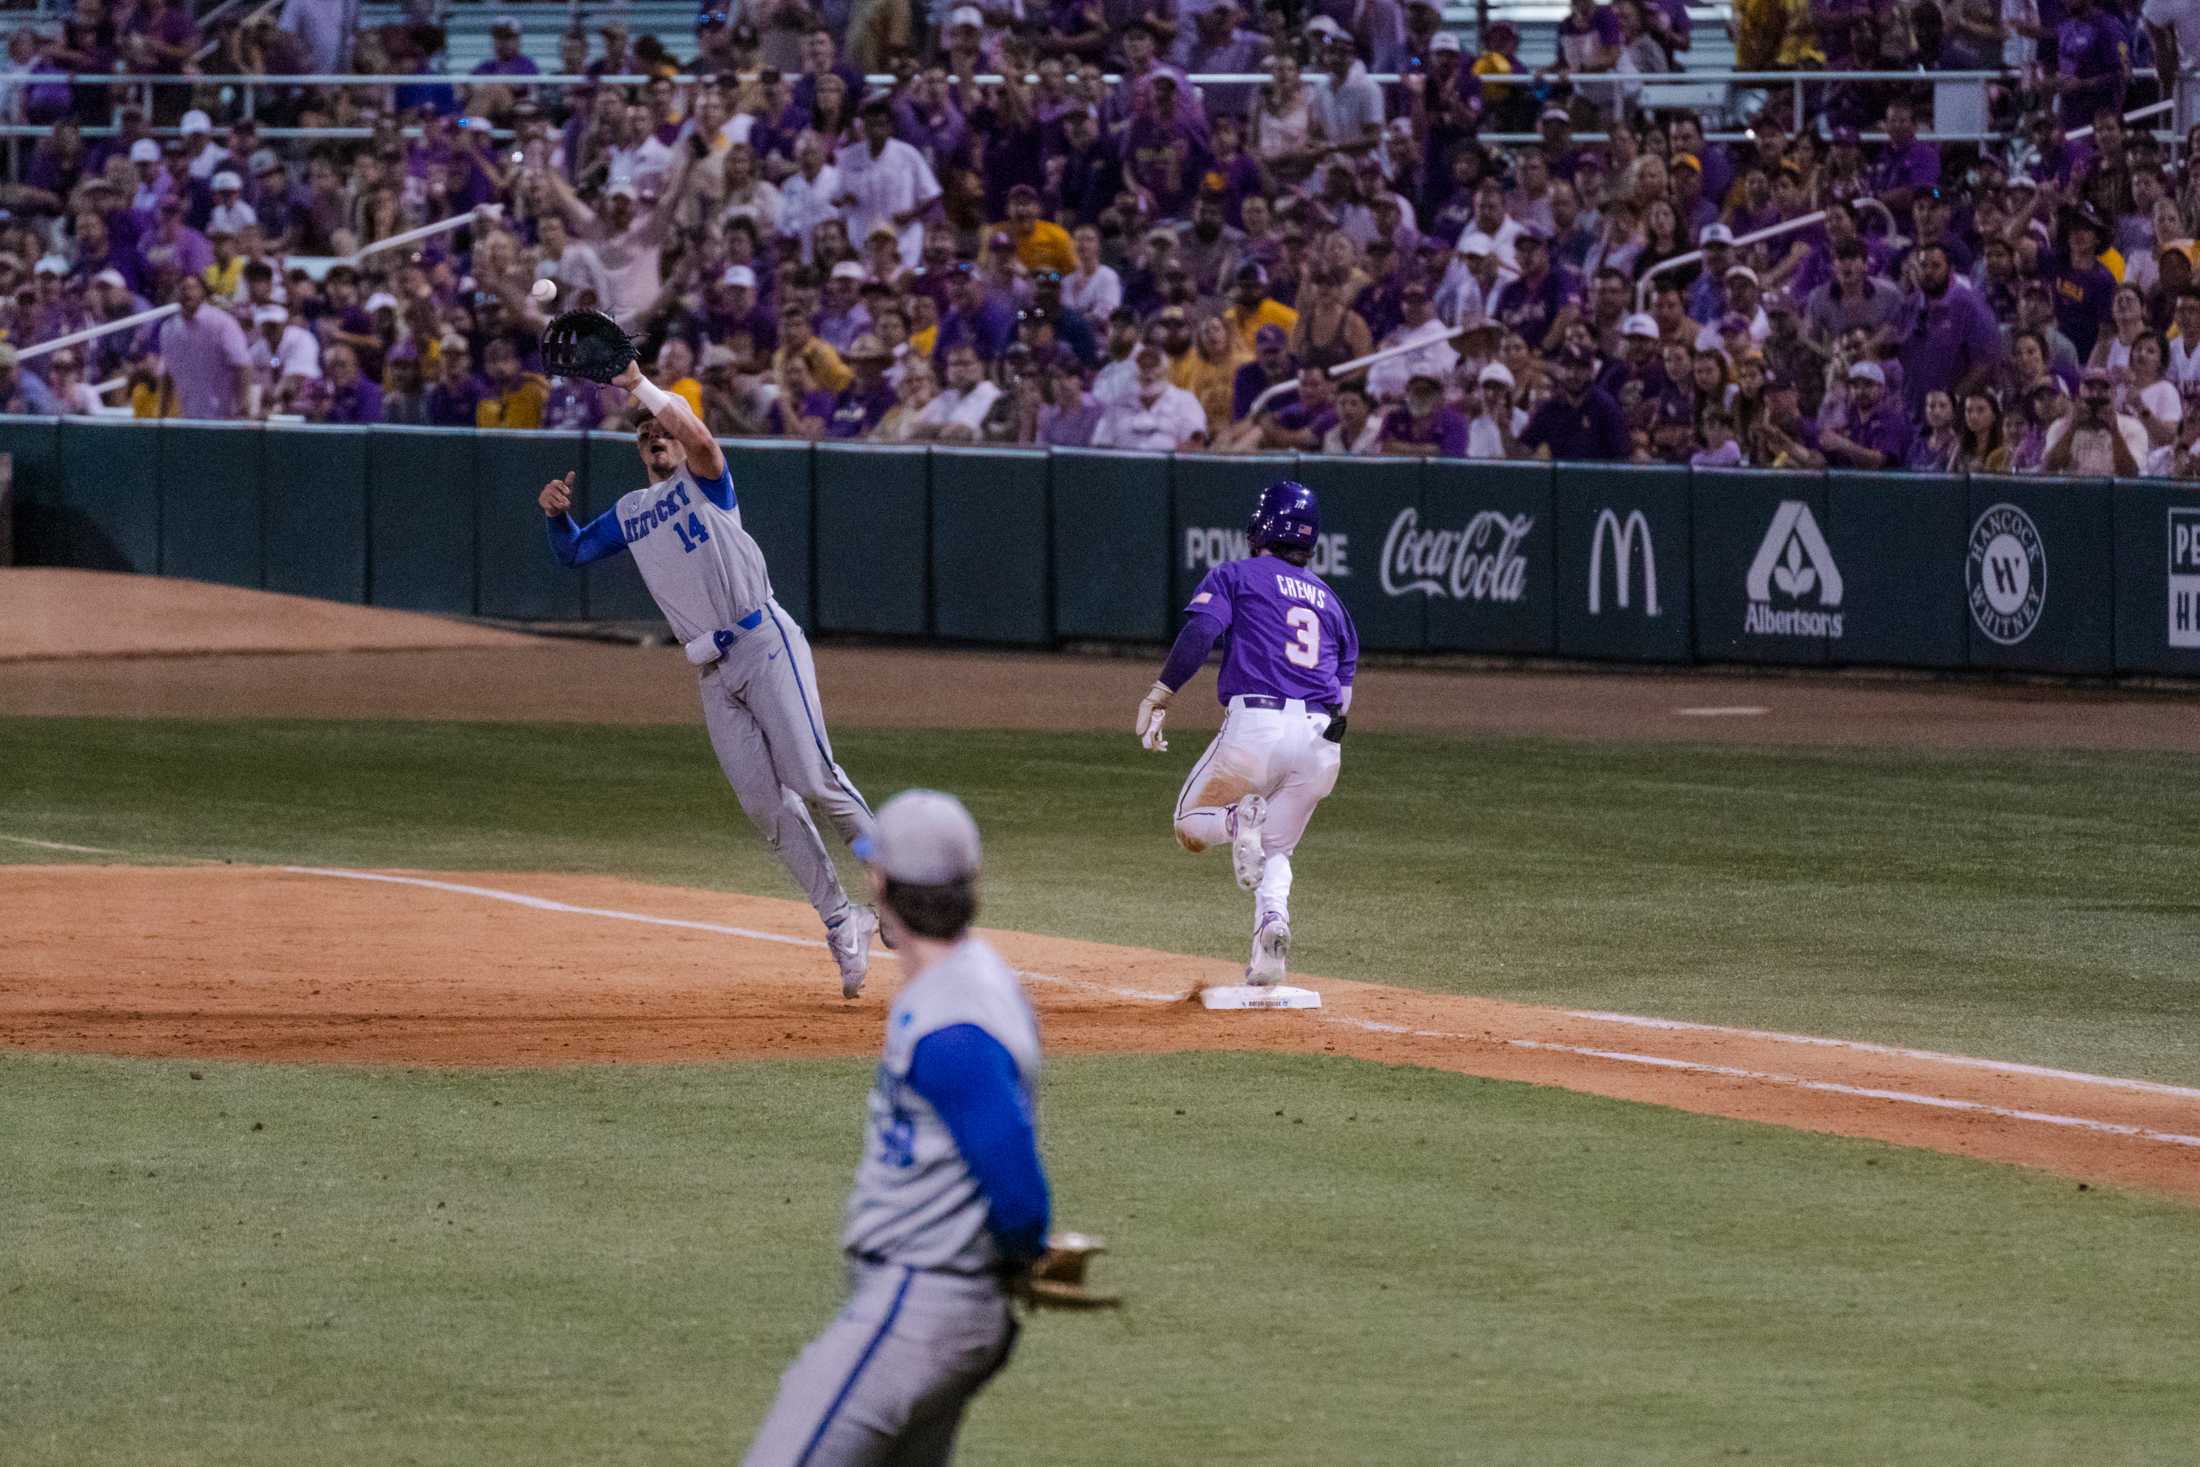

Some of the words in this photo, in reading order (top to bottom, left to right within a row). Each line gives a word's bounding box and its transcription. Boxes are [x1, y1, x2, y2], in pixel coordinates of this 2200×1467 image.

[673, 513, 709, 553] 14
[1285, 521, 1292, 531] 3
[1971, 511, 2040, 563] HANCOCK
[1185, 527, 1350, 576] POWDE
[1380, 507, 1535, 601] Coca-Cola
[1276, 574, 1325, 608] CREWS
[1972, 581, 2040, 636] WHITNEY
[1285, 606, 1320, 669] 3
[1744, 602, 1842, 638] Albertsons
